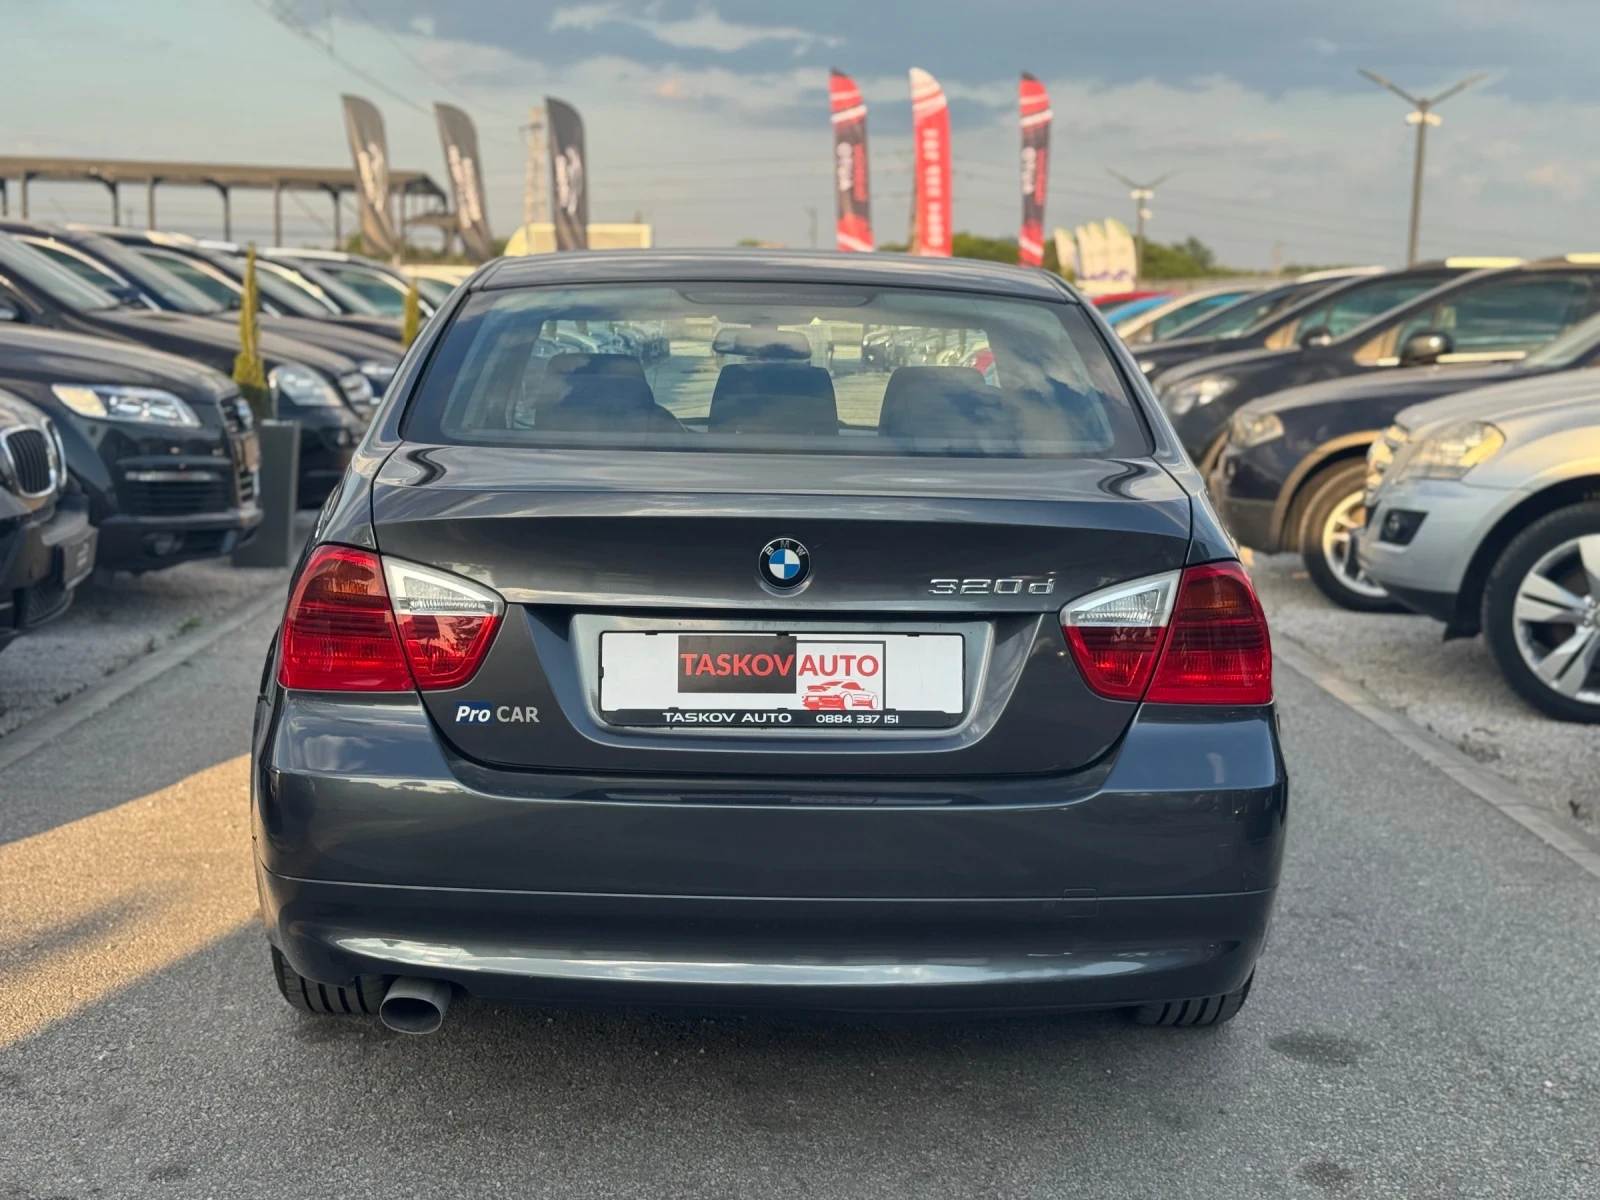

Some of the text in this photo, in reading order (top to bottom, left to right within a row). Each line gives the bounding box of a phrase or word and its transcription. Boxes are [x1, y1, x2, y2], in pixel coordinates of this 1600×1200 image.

[764, 538, 806, 557] BMW
[928, 577, 1056, 596] 320d
[681, 653, 879, 677] TASKOV AUTO
[456, 705, 540, 723] Pro CAR
[662, 712, 899, 724] TASKOV AUTO 0884 337 151
